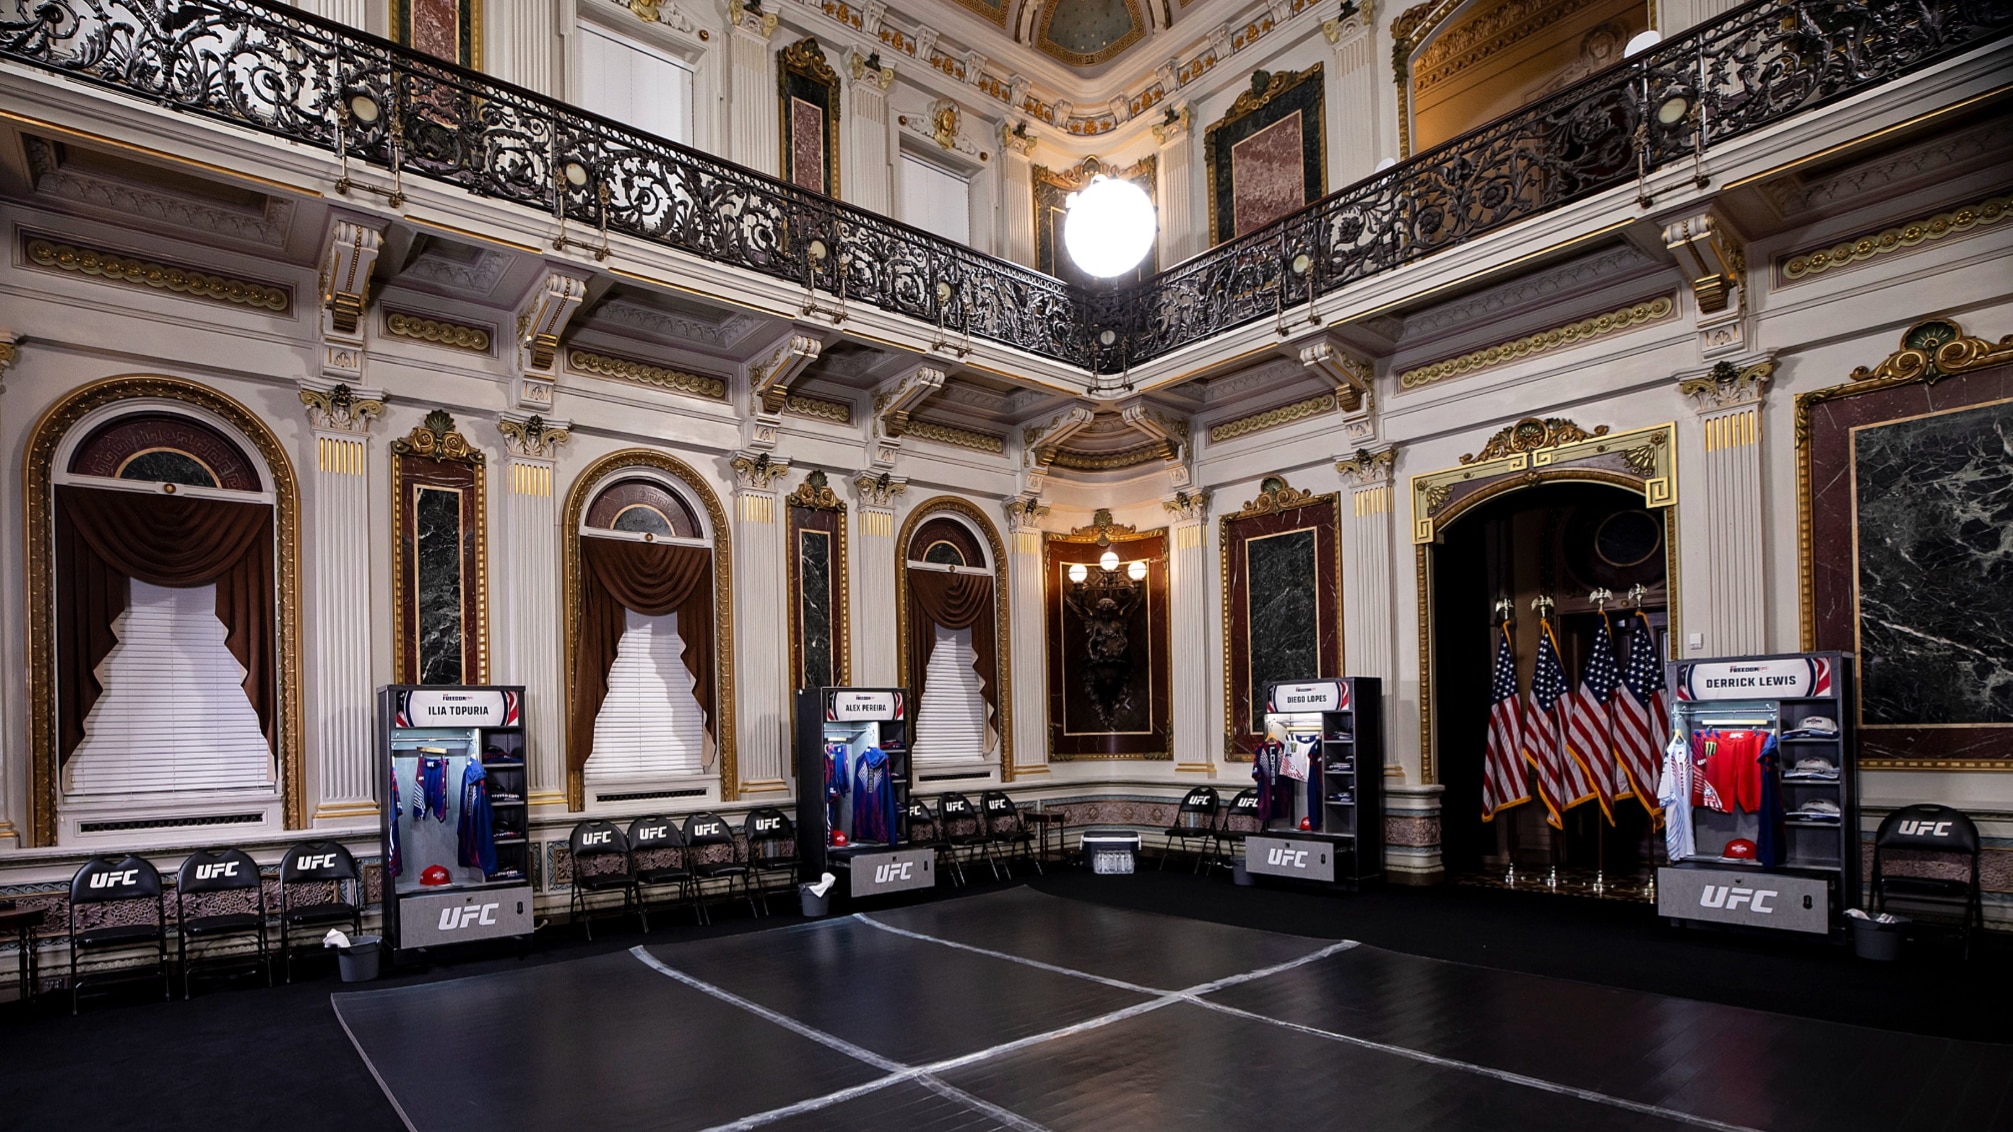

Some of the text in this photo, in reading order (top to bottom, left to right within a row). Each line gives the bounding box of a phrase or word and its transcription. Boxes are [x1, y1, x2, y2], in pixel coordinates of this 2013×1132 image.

[1706, 675, 1796, 688] DERRICK LEWIS
[428, 706, 489, 715] ILIA TOPURIA
[946, 801, 964, 812] UFC
[989, 799, 1006, 810] UFC
[1188, 795, 1211, 805] UFC
[909, 805, 921, 816] FC
[695, 822, 719, 836] UFC
[756, 817, 780, 830] UFC
[1898, 820, 1952, 836] UFC
[583, 831, 611, 845] UFC
[639, 826, 667, 839] UFC
[297, 853, 336, 871] UFC
[1267, 848, 1308, 868] UFC
[196, 861, 239, 880] UFC
[875, 862, 913, 883] UFC
[90, 869, 139, 889] UFC
[1700, 885, 1778, 913] UFC
[438, 903, 499, 930] UFC
